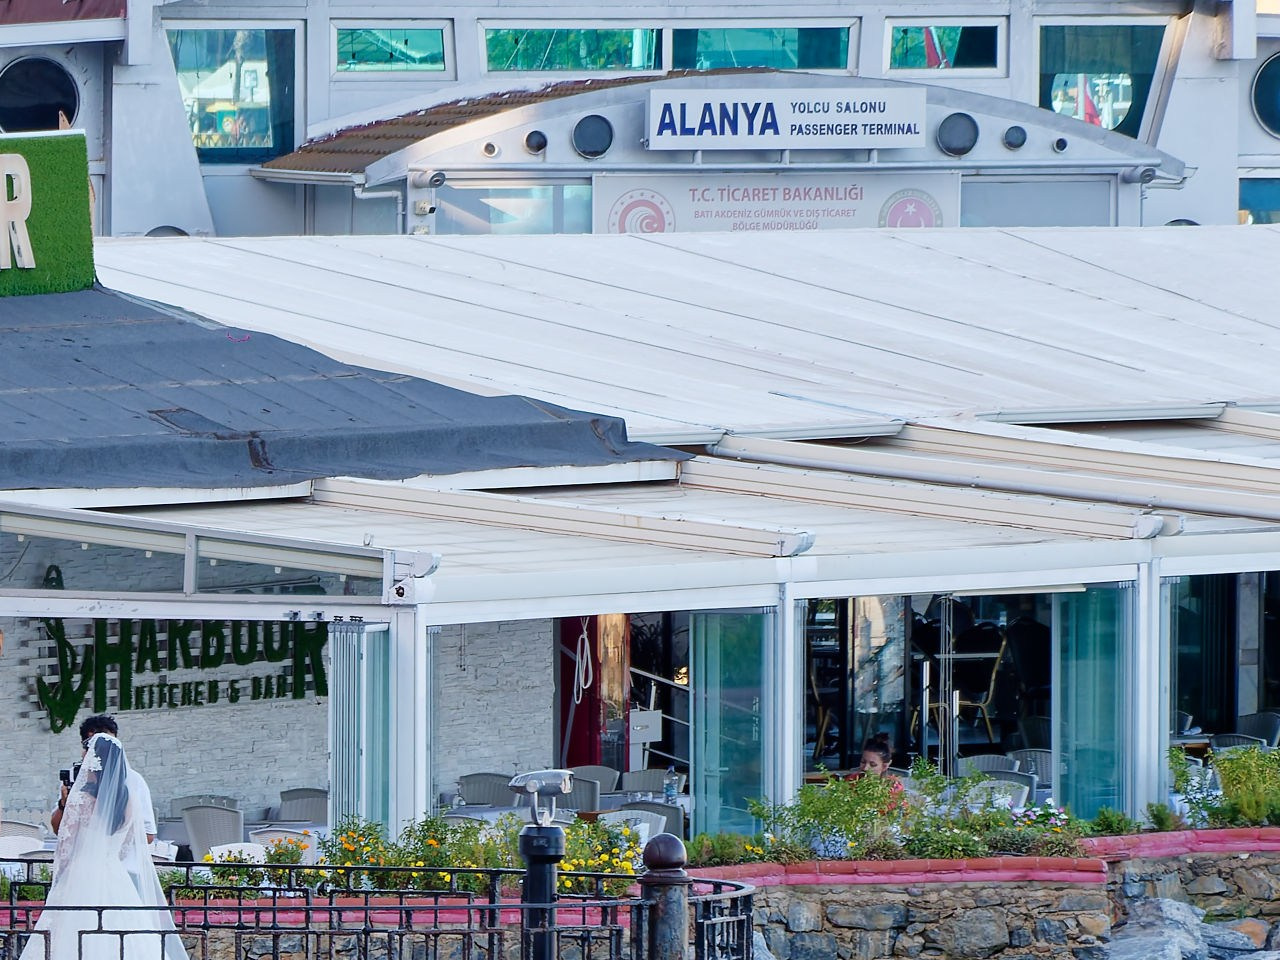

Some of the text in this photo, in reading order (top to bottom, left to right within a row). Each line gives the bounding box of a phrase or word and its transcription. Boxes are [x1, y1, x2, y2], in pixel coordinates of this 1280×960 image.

[790, 101, 886, 114] YOLCU SALONU
[656, 102, 780, 136] ALANYA
[790, 123, 920, 136] PASSENGER TERMINAL
[689, 184, 863, 202] T.C. TİCARET BAKANLIĞI
[694, 210, 713, 219] BATI
[793, 209, 805, 218] VE
[822, 207, 857, 217] TİCARET
[732, 221, 761, 231] BÖLGE
